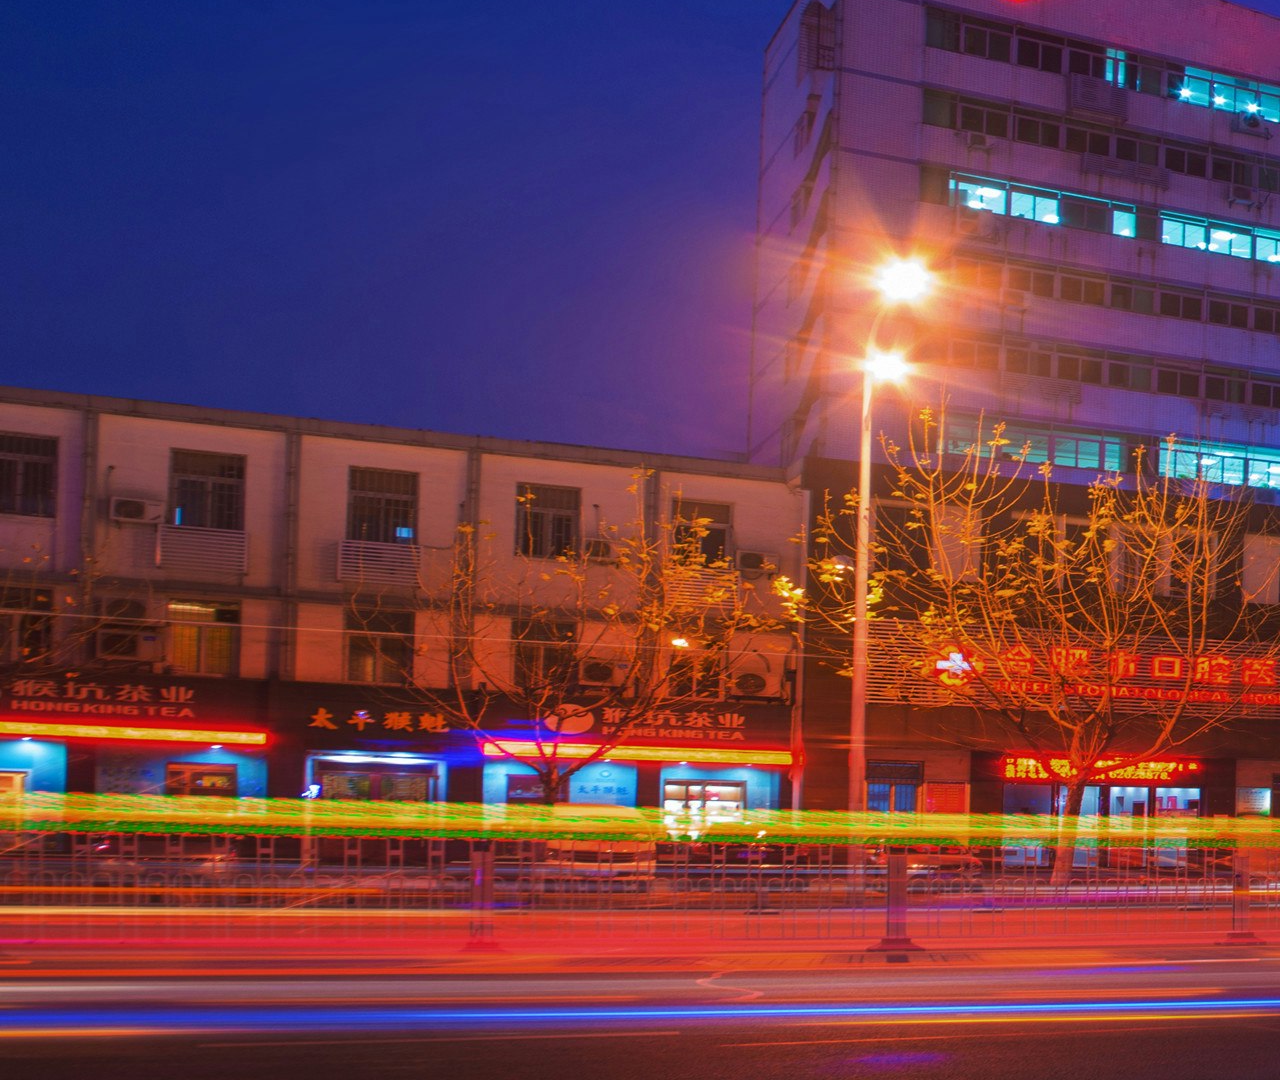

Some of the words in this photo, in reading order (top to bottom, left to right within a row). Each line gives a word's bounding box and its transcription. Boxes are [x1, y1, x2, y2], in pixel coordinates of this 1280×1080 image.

[10, 679, 196, 704] 猴坑茶业
[144, 706, 196, 718] TEA
[307, 706, 450, 733] 太平猴魁
[705, 730, 745, 741] TEA
